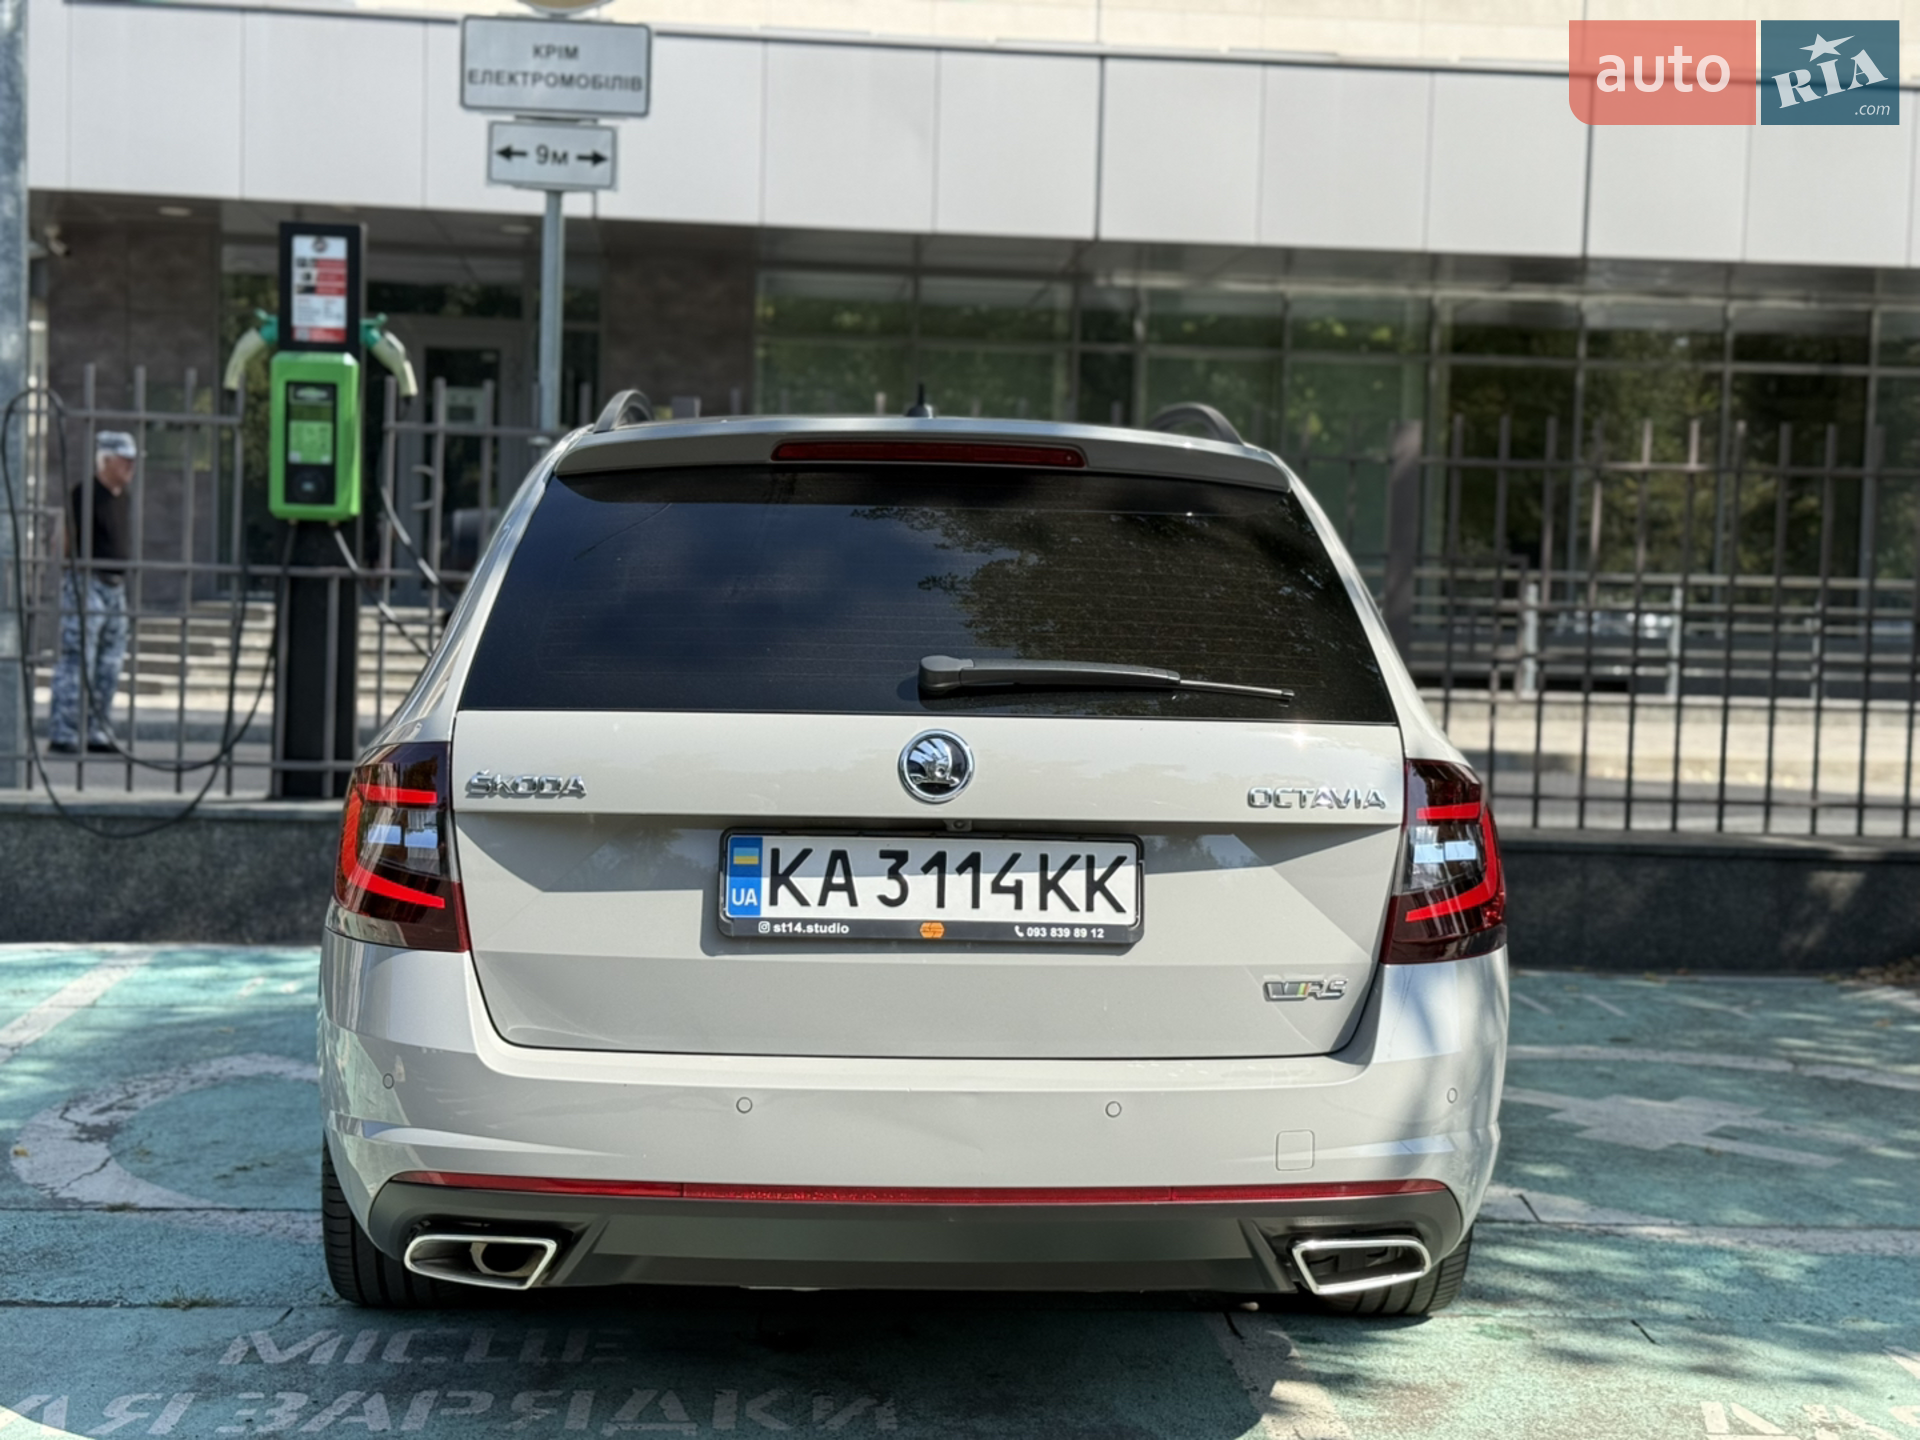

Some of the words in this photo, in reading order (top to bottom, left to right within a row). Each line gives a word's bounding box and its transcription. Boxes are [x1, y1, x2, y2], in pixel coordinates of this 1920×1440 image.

[533, 45, 579, 60] КРІМ
[467, 69, 643, 92] ЕЛЕКТРОМОБІЛІВ
[1247, 786, 1386, 810] OCTAVIA
[732, 888, 758, 906] UA
[773, 922, 850, 934] st14.studio
[1026, 927, 1047, 937] 093
[1050, 927, 1071, 938] 839
[1073, 928, 1088, 938] 89
[1090, 928, 1105, 938] 12
